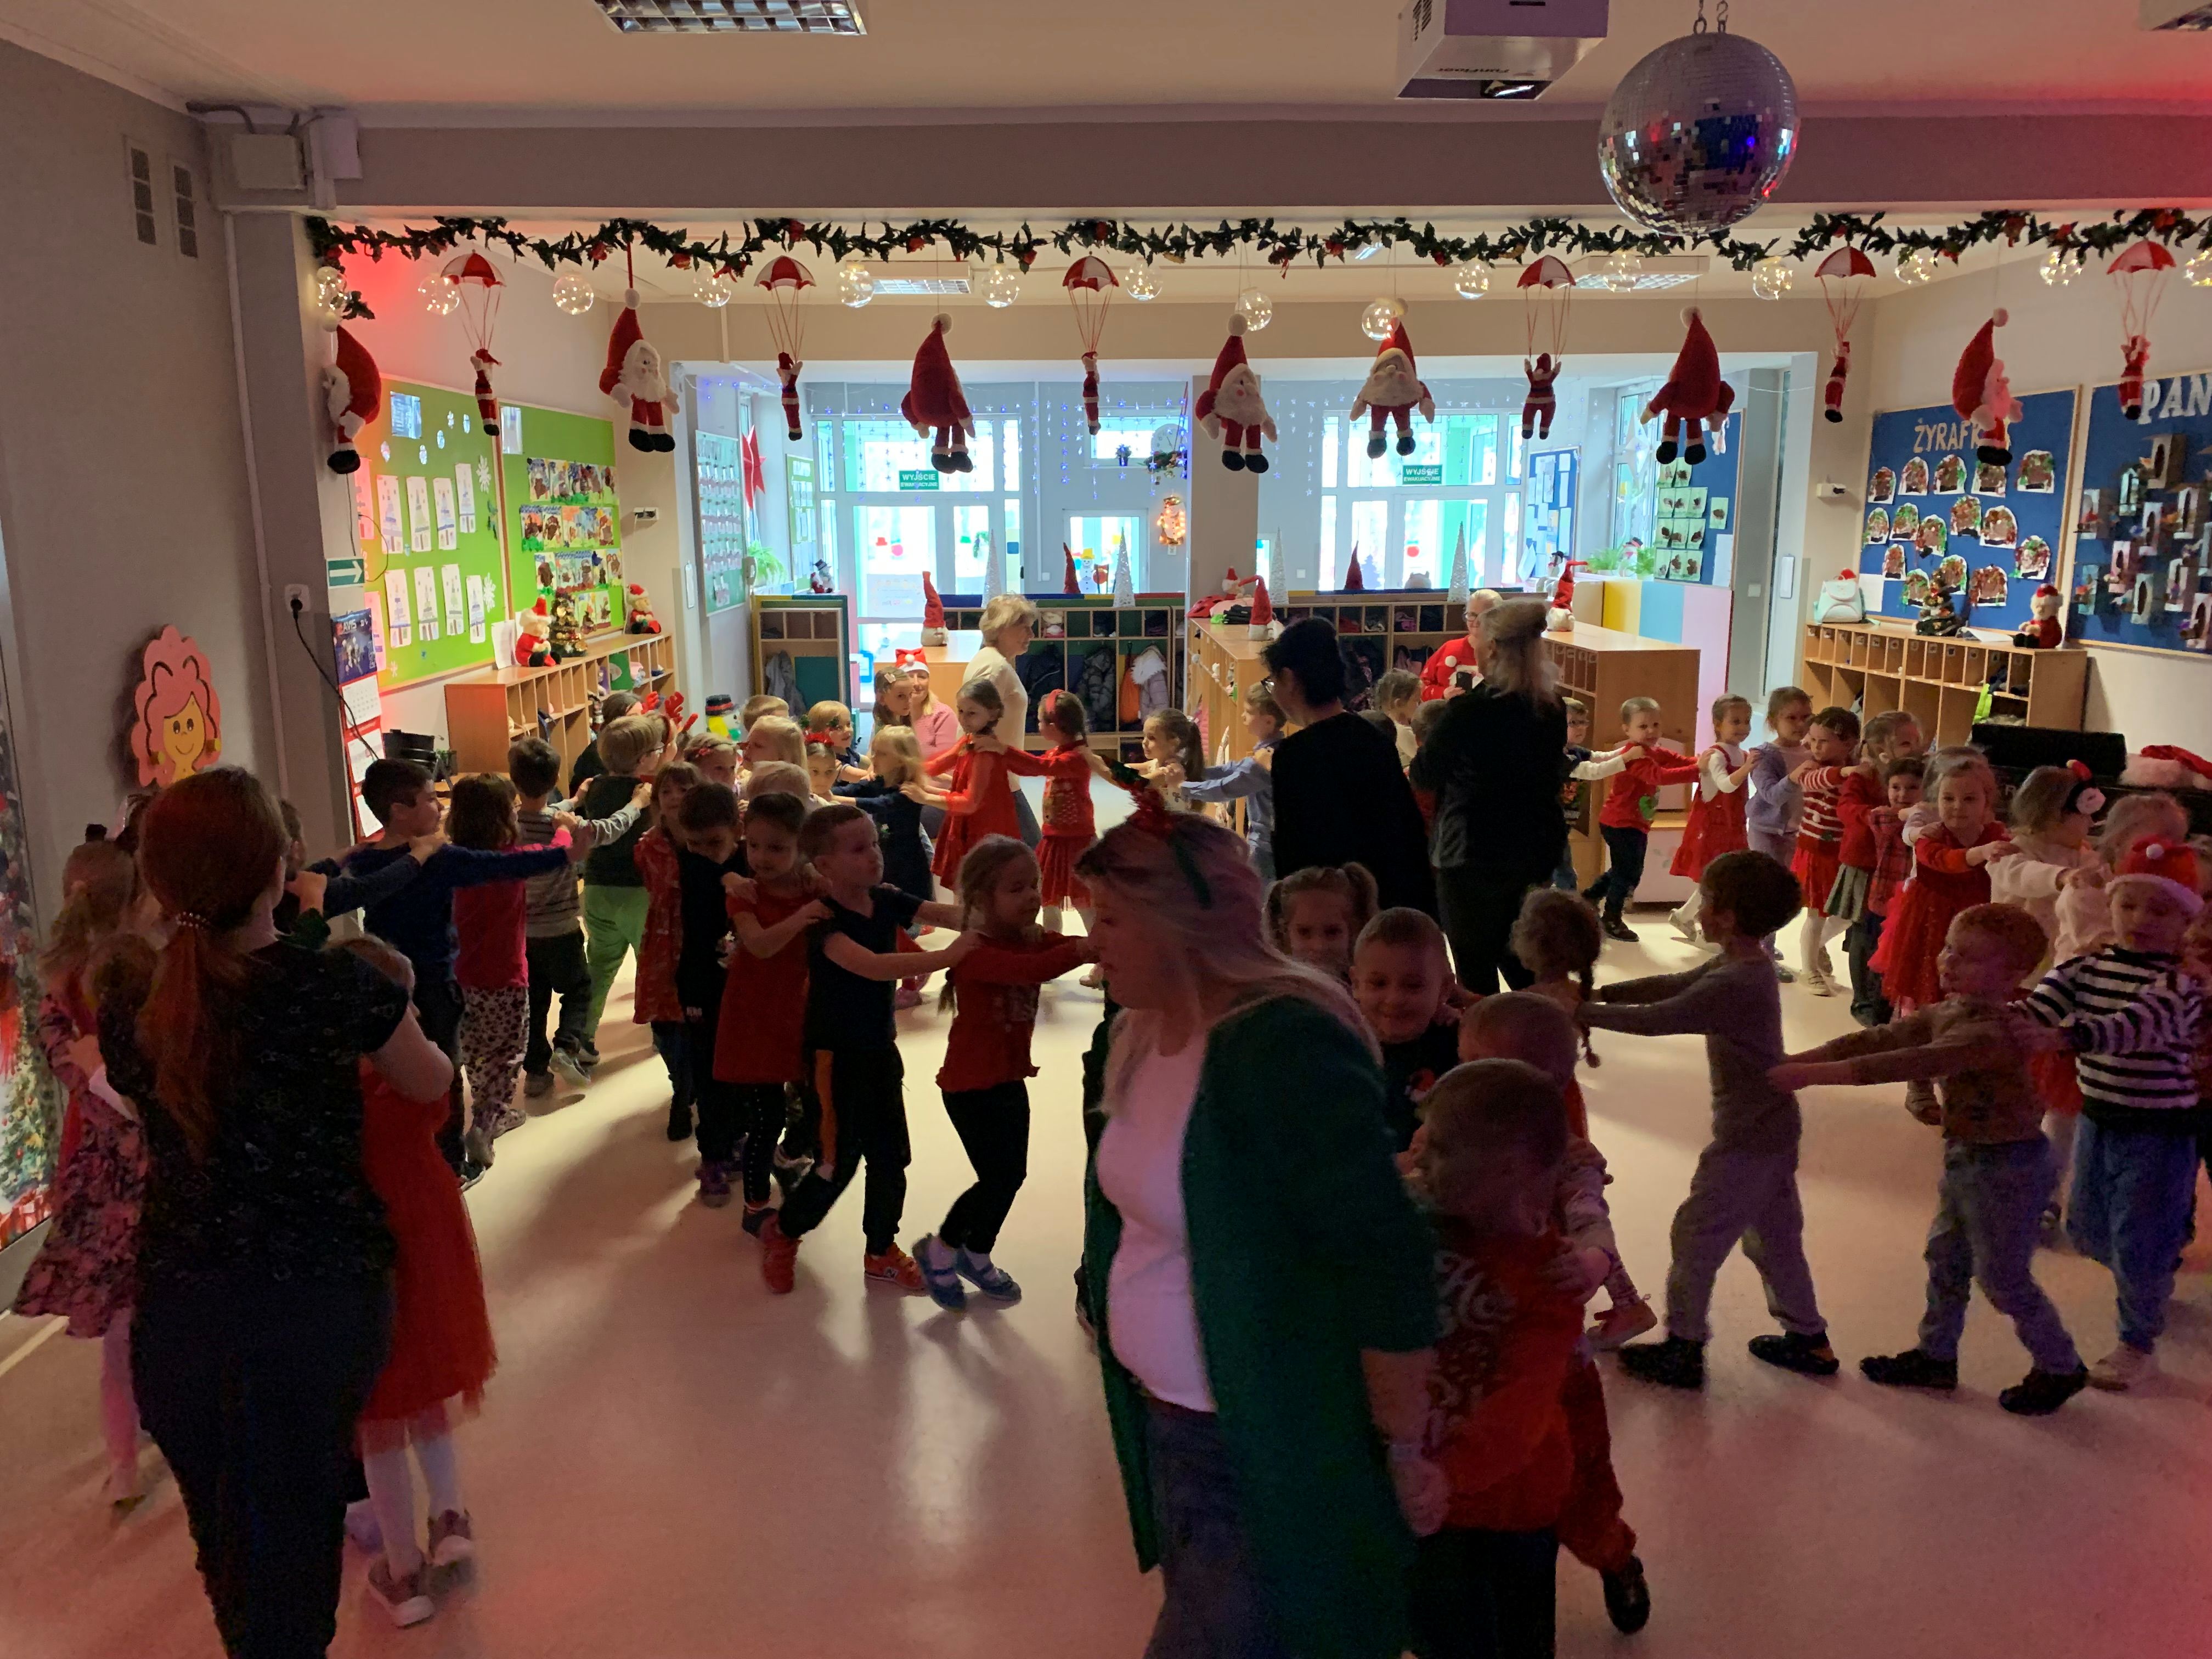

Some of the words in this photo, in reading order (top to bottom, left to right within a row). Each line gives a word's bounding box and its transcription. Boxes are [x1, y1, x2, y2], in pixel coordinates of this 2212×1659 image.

[1914, 417, 1987, 453] ŻYRAFK
[1406, 467, 1440, 475] WYJŚCIE
[902, 472, 936, 481] WYJŚCIE
